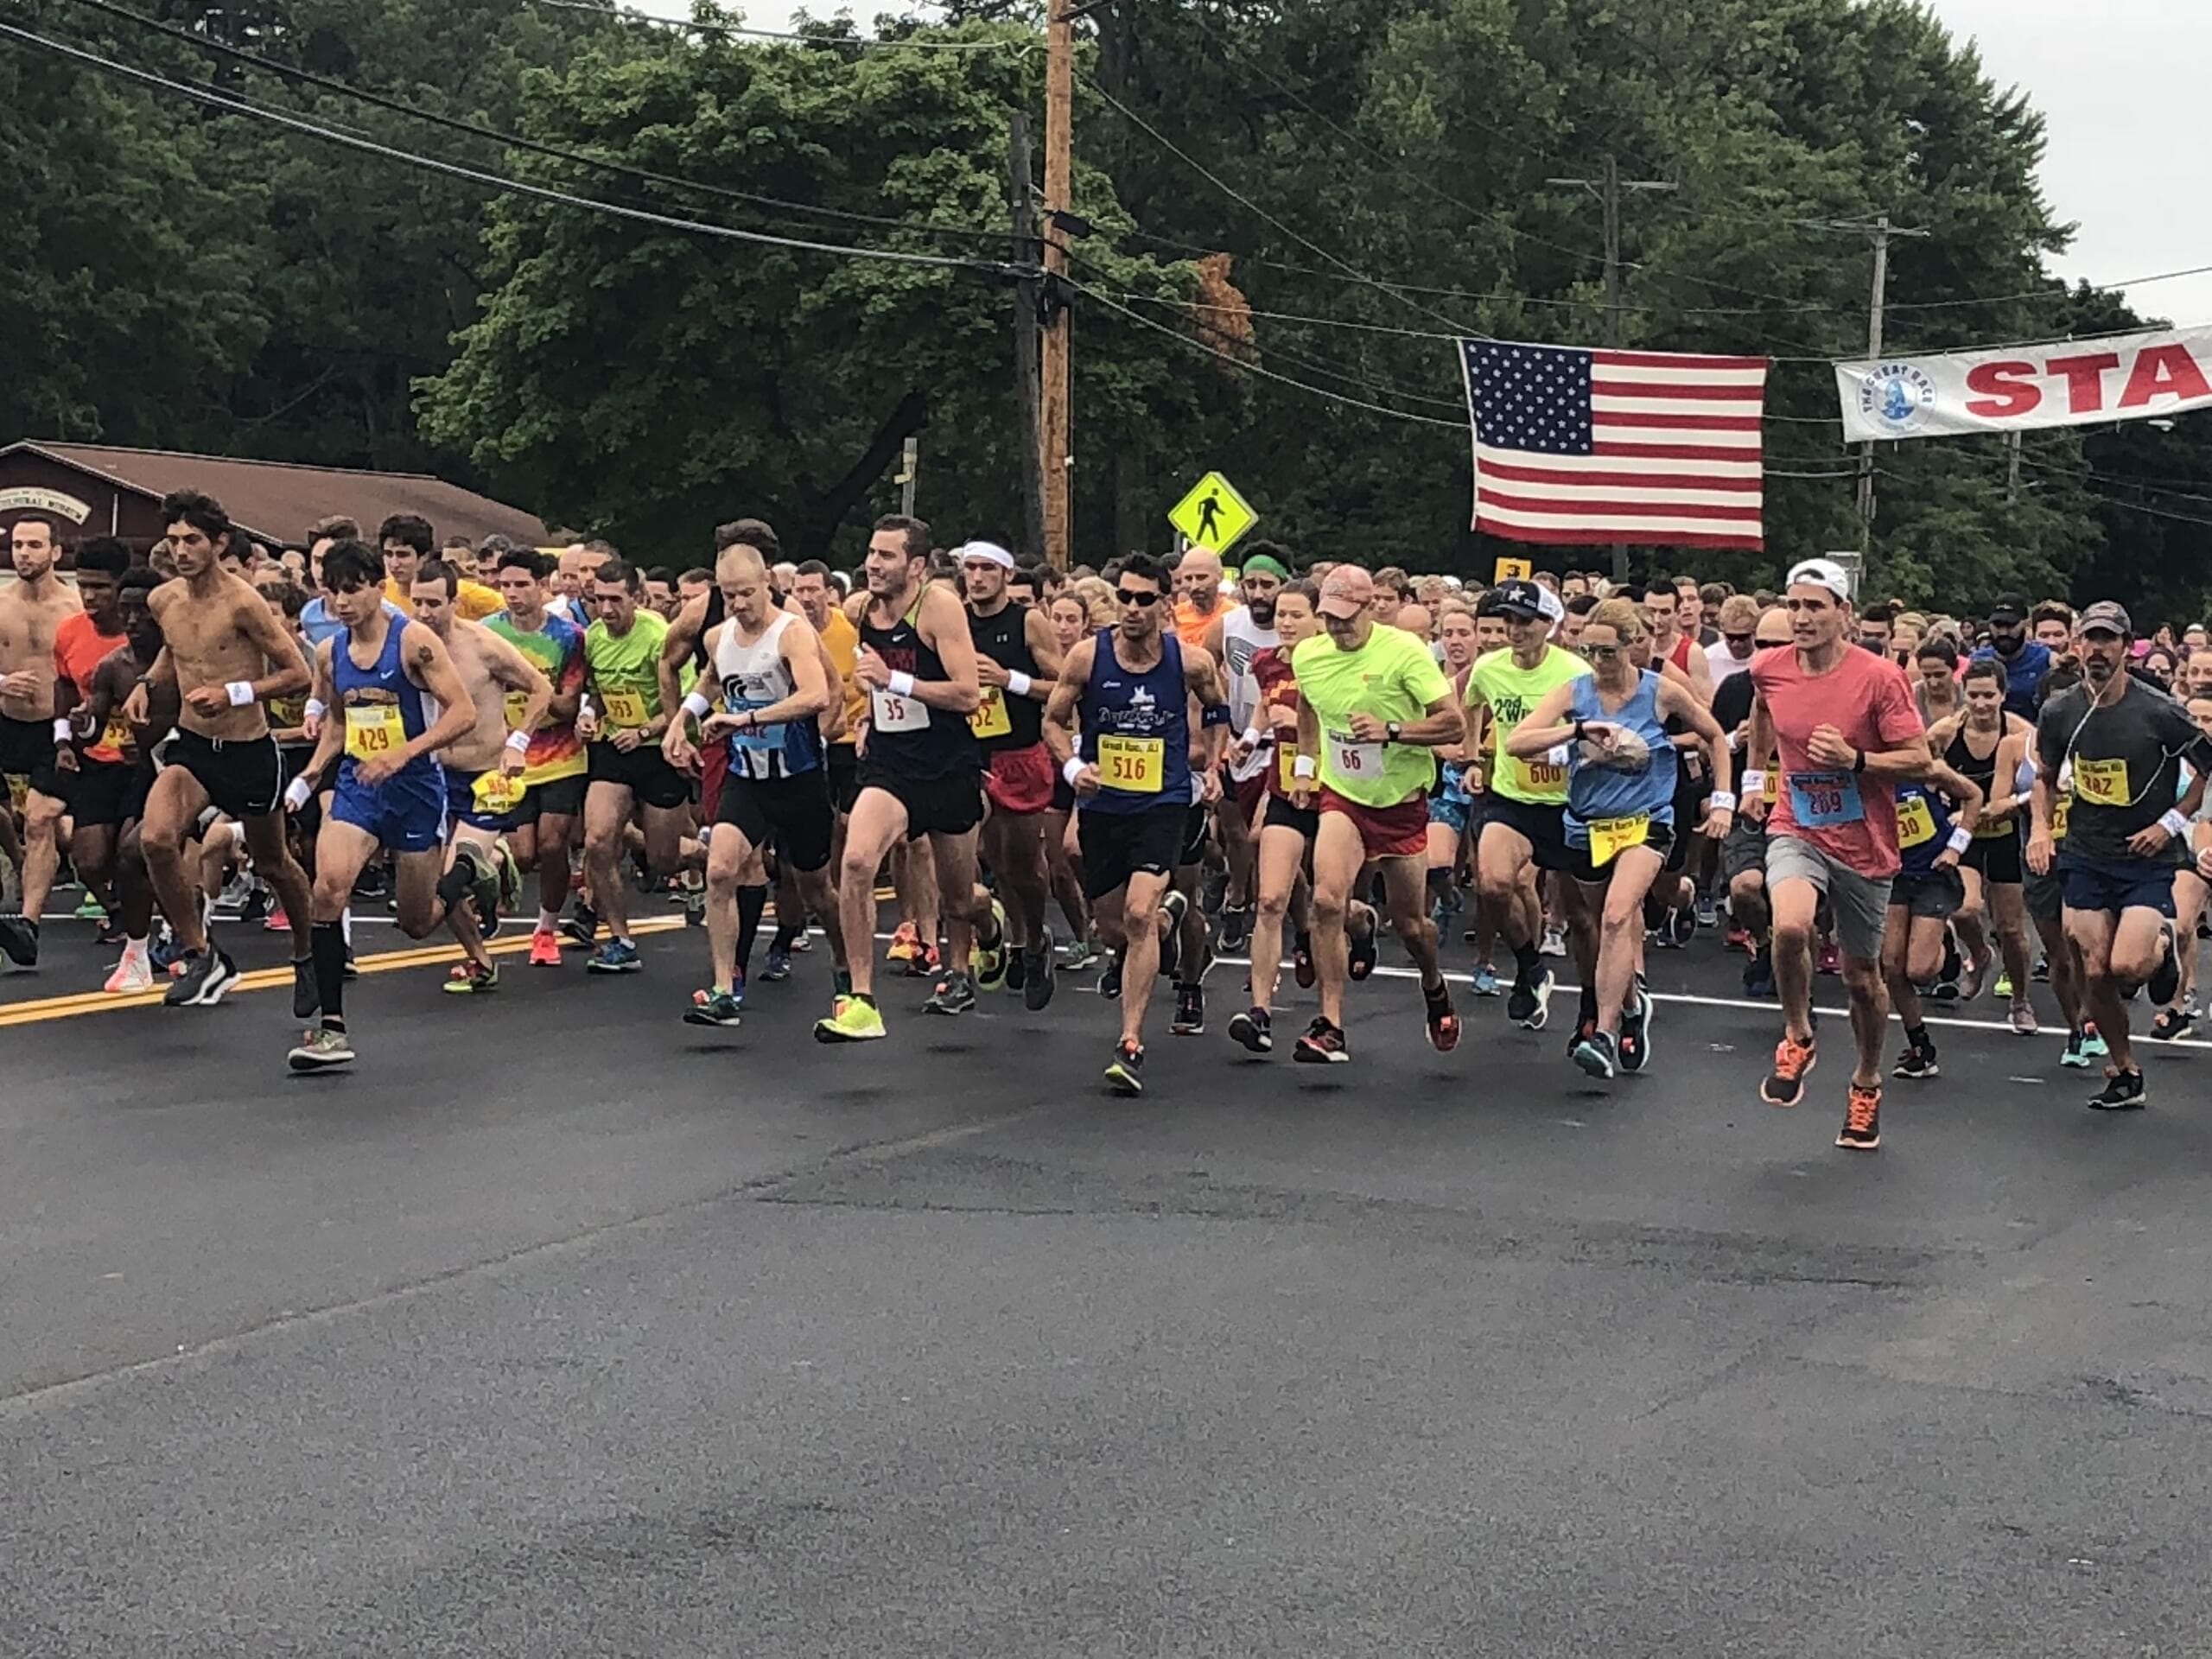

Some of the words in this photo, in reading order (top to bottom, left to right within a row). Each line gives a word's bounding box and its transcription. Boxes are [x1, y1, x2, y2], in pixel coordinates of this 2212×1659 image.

[1506, 563, 1521, 578] 3
[884, 697, 905, 721] 35
[359, 728, 389, 752] 429
[1112, 755, 1146, 780] 516
[1342, 749, 1361, 770] 66
